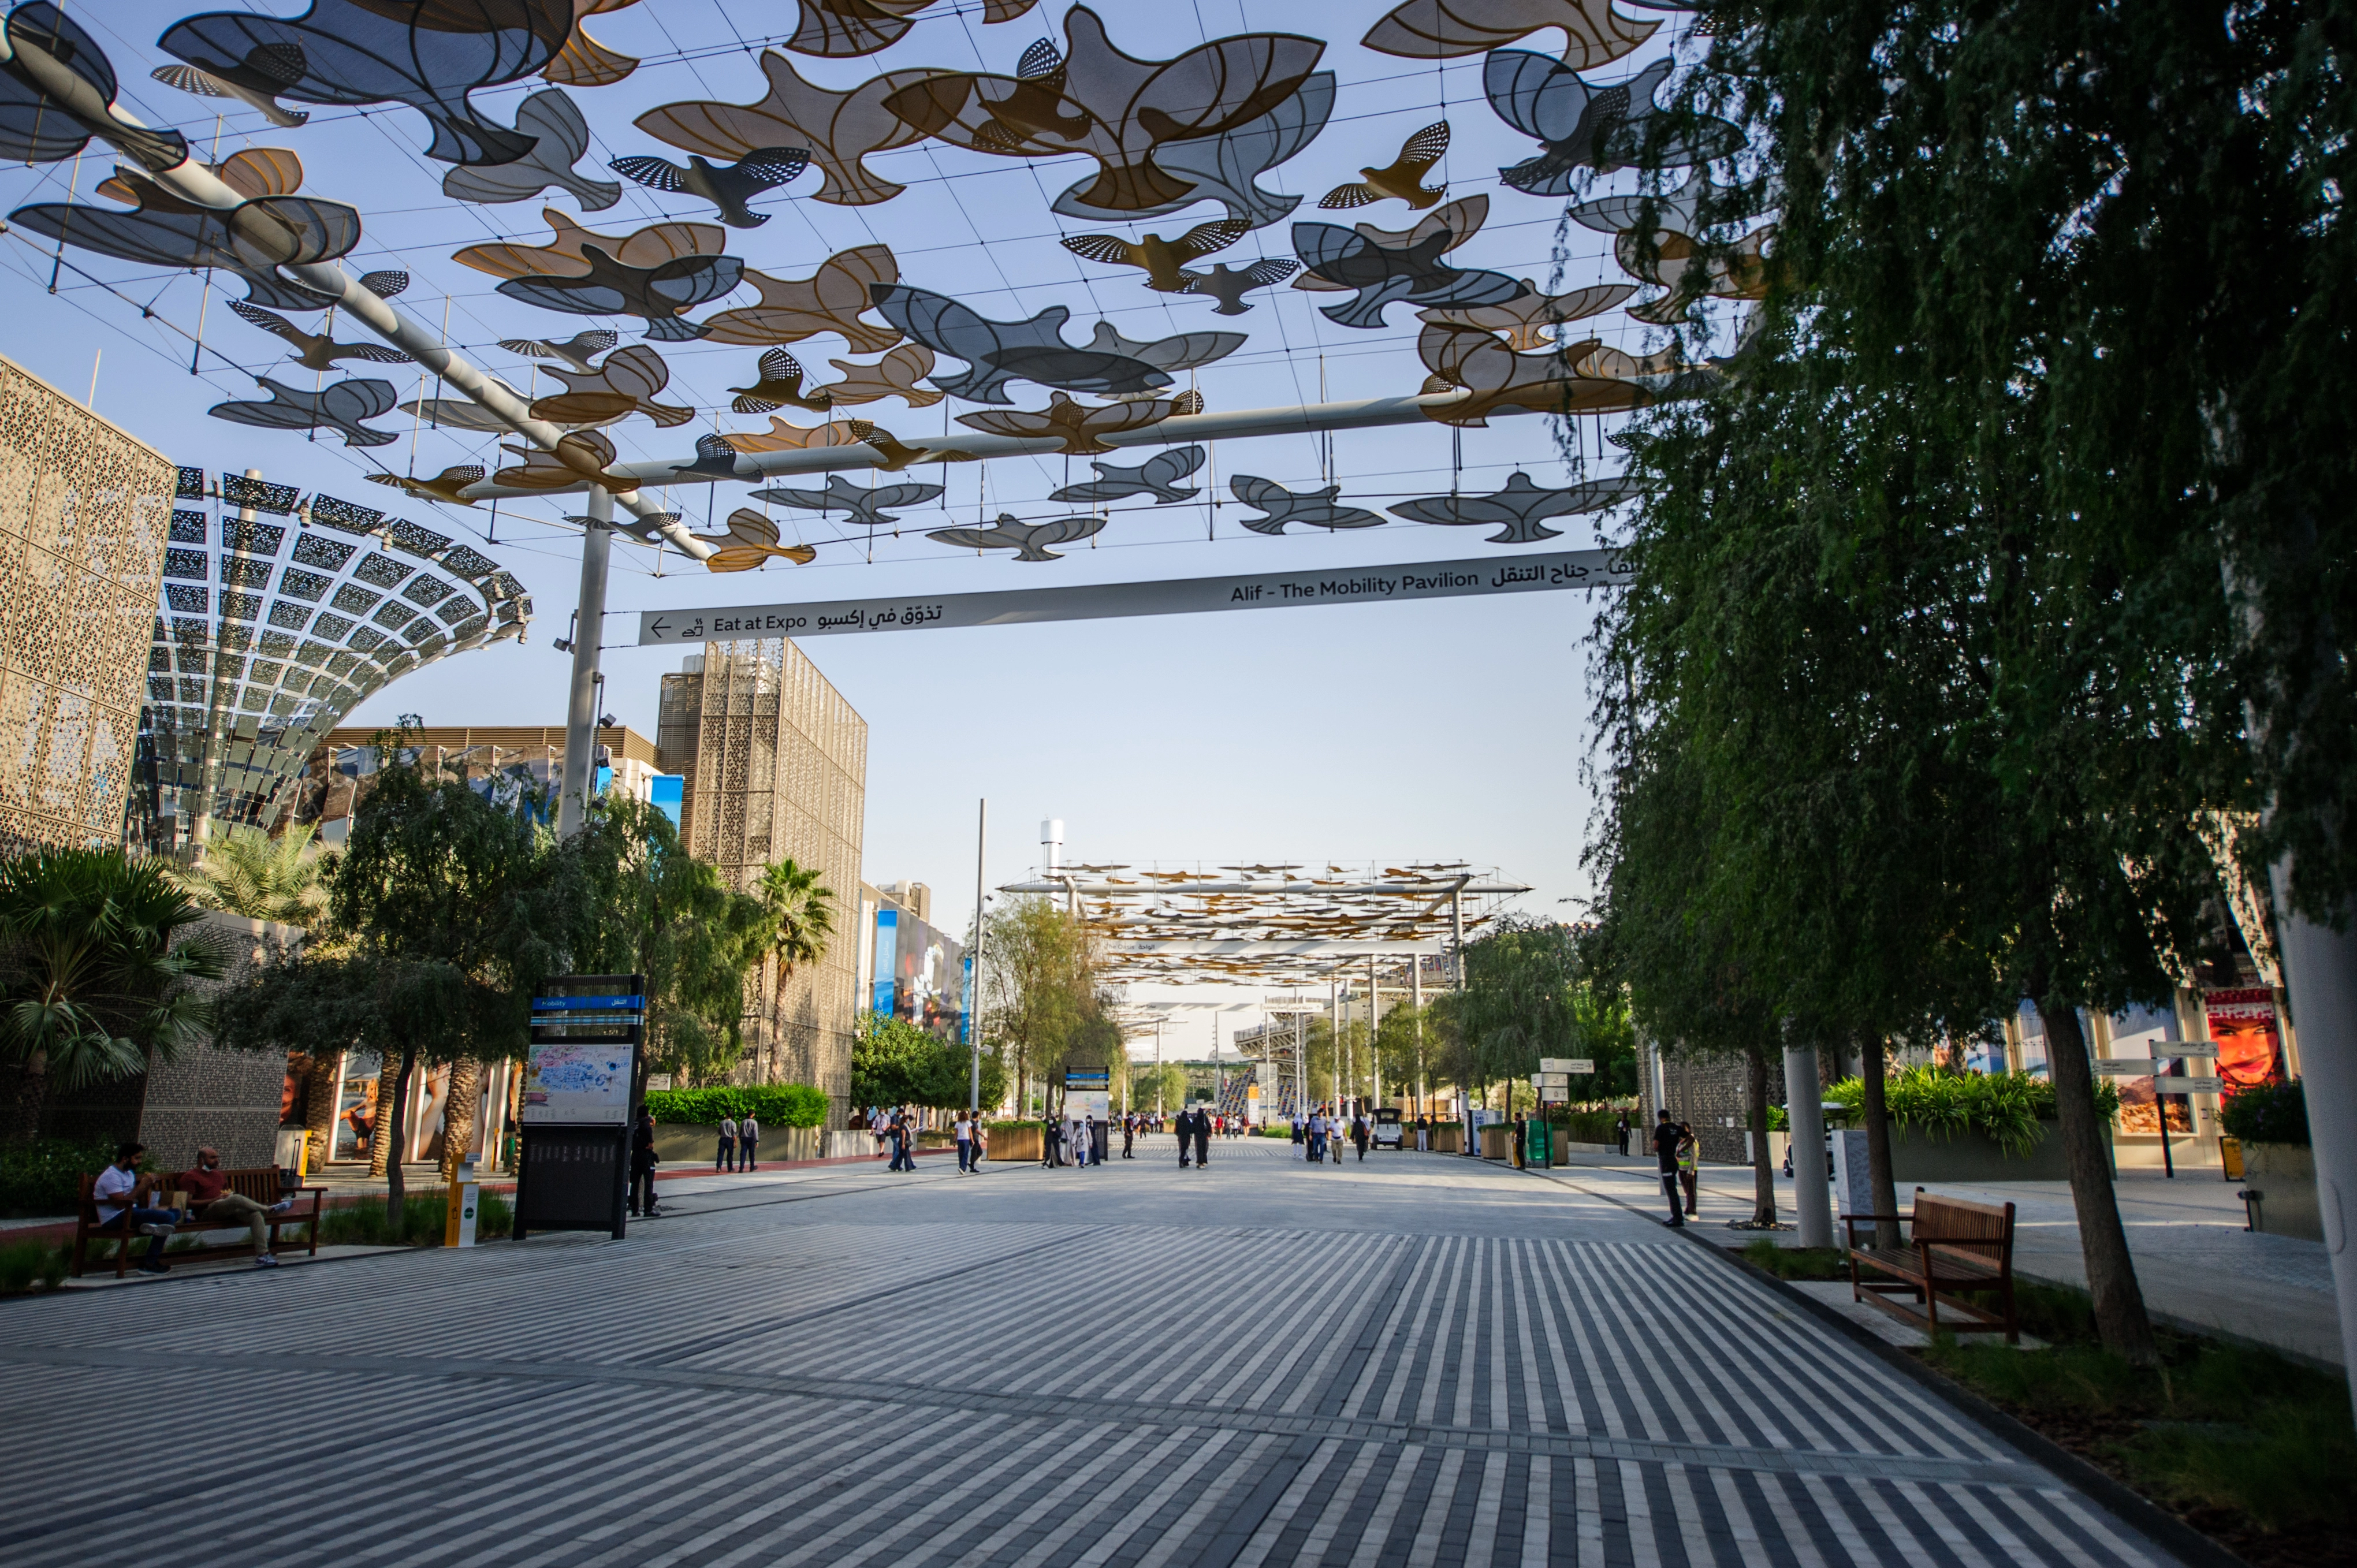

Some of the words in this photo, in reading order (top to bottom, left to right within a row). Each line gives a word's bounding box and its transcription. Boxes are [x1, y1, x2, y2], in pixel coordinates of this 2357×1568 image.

[1551, 563, 1590, 584] جناح
[1608, 557, 1640, 575] لف
[1492, 565, 1545, 587] التنقل
[1231, 585, 1263, 602] Alif
[1279, 583, 1315, 598] The
[1320, 578, 1397, 596] Mobility
[1402, 572, 1479, 591] Pavilion
[714, 617, 741, 631] Eat
[744, 616, 761, 630] at
[766, 615, 807, 632] Expo
[817, 610, 865, 630] إكسبو
[869, 608, 896, 630] في
[1138, 943, 1155, 951] الواحة
[541, 1000, 566, 1008] Mobility
[611, 999, 627, 1007] التنقل
